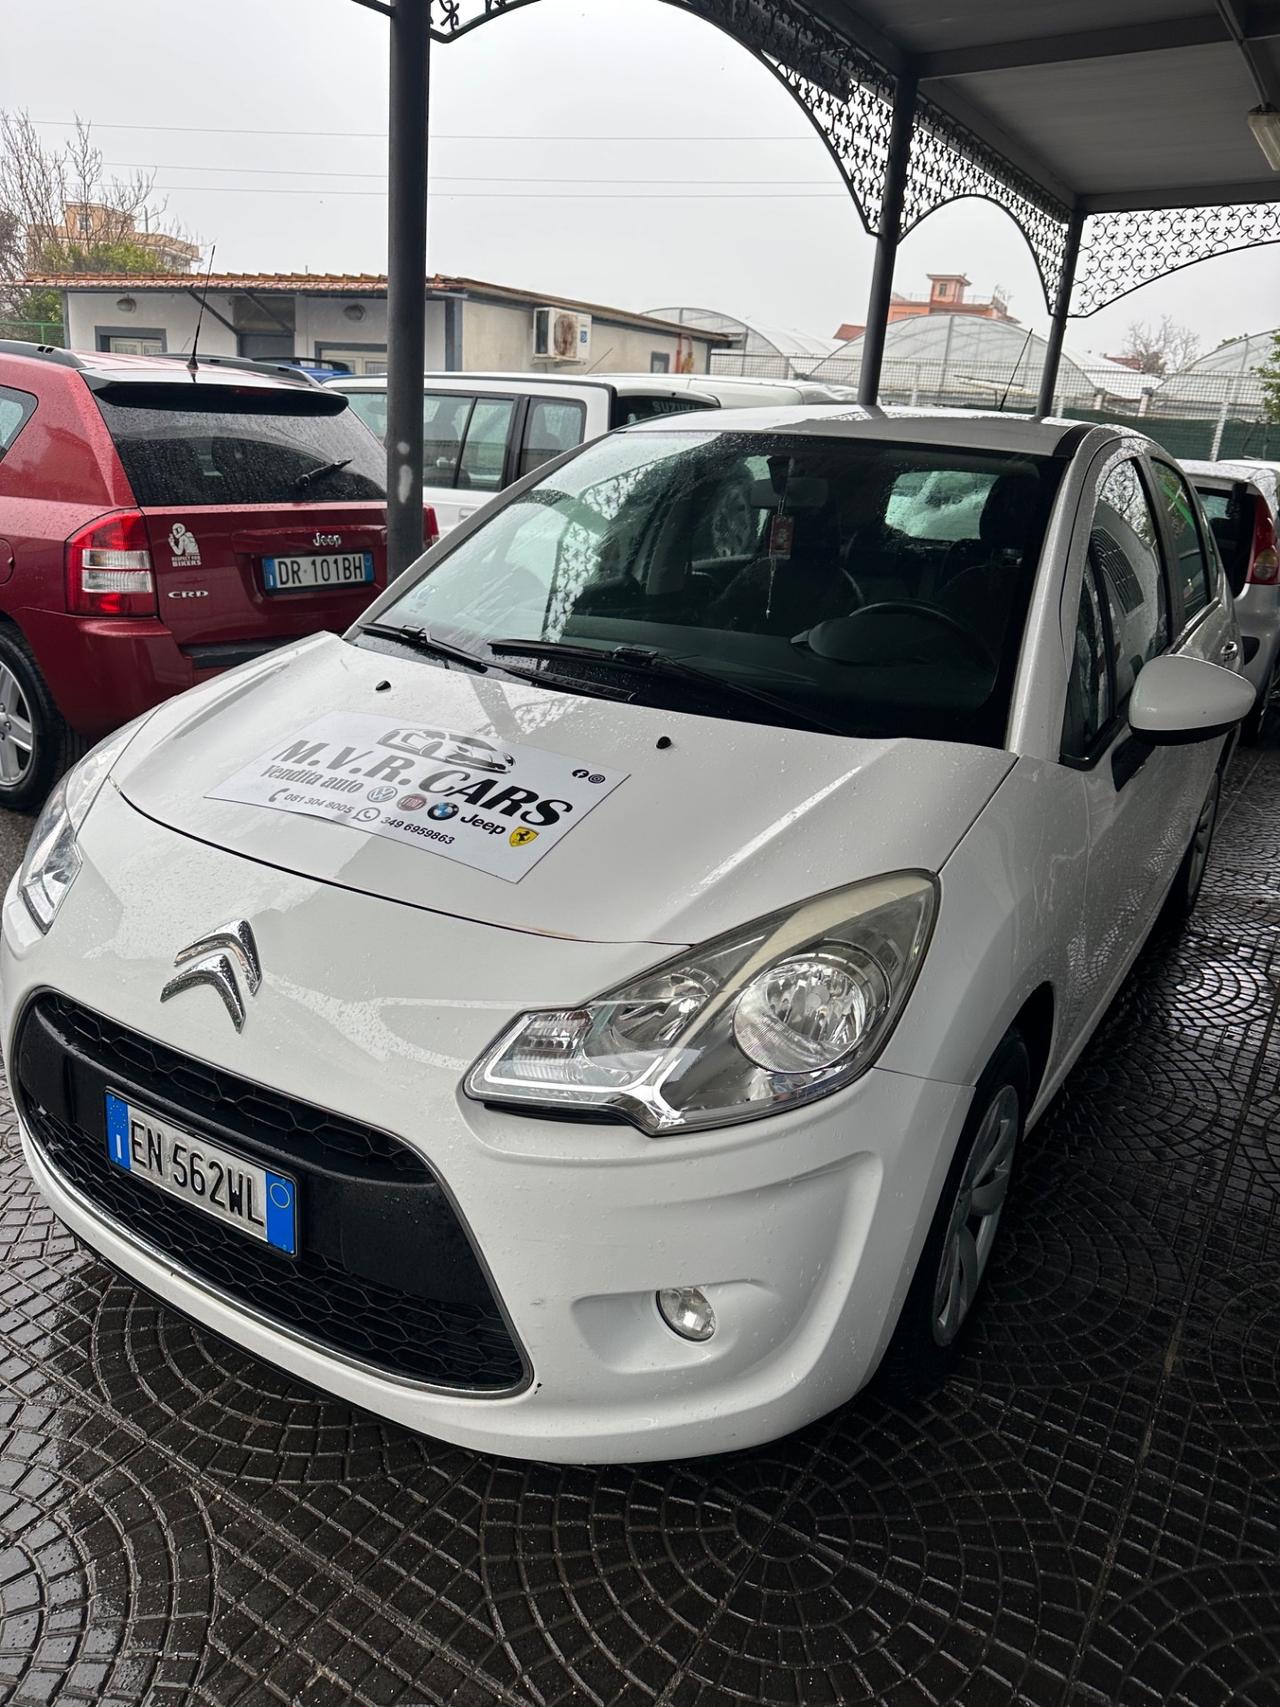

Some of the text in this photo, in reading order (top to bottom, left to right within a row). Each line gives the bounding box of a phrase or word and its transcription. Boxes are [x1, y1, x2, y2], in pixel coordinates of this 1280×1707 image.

[312, 532, 342, 548] Jeep
[277, 560, 302, 585] DR
[311, 556, 363, 583] 101BH
[260, 764, 364, 793] Vendita auto
[284, 793, 303, 802] 081
[325, 801, 355, 814] 8005
[418, 769, 573, 827] CARS
[380, 816, 455, 845] 349 6959863
[460, 814, 506, 835] Jeep
[131, 1120, 163, 1176] EN
[172, 1143, 264, 1227] 562WL
